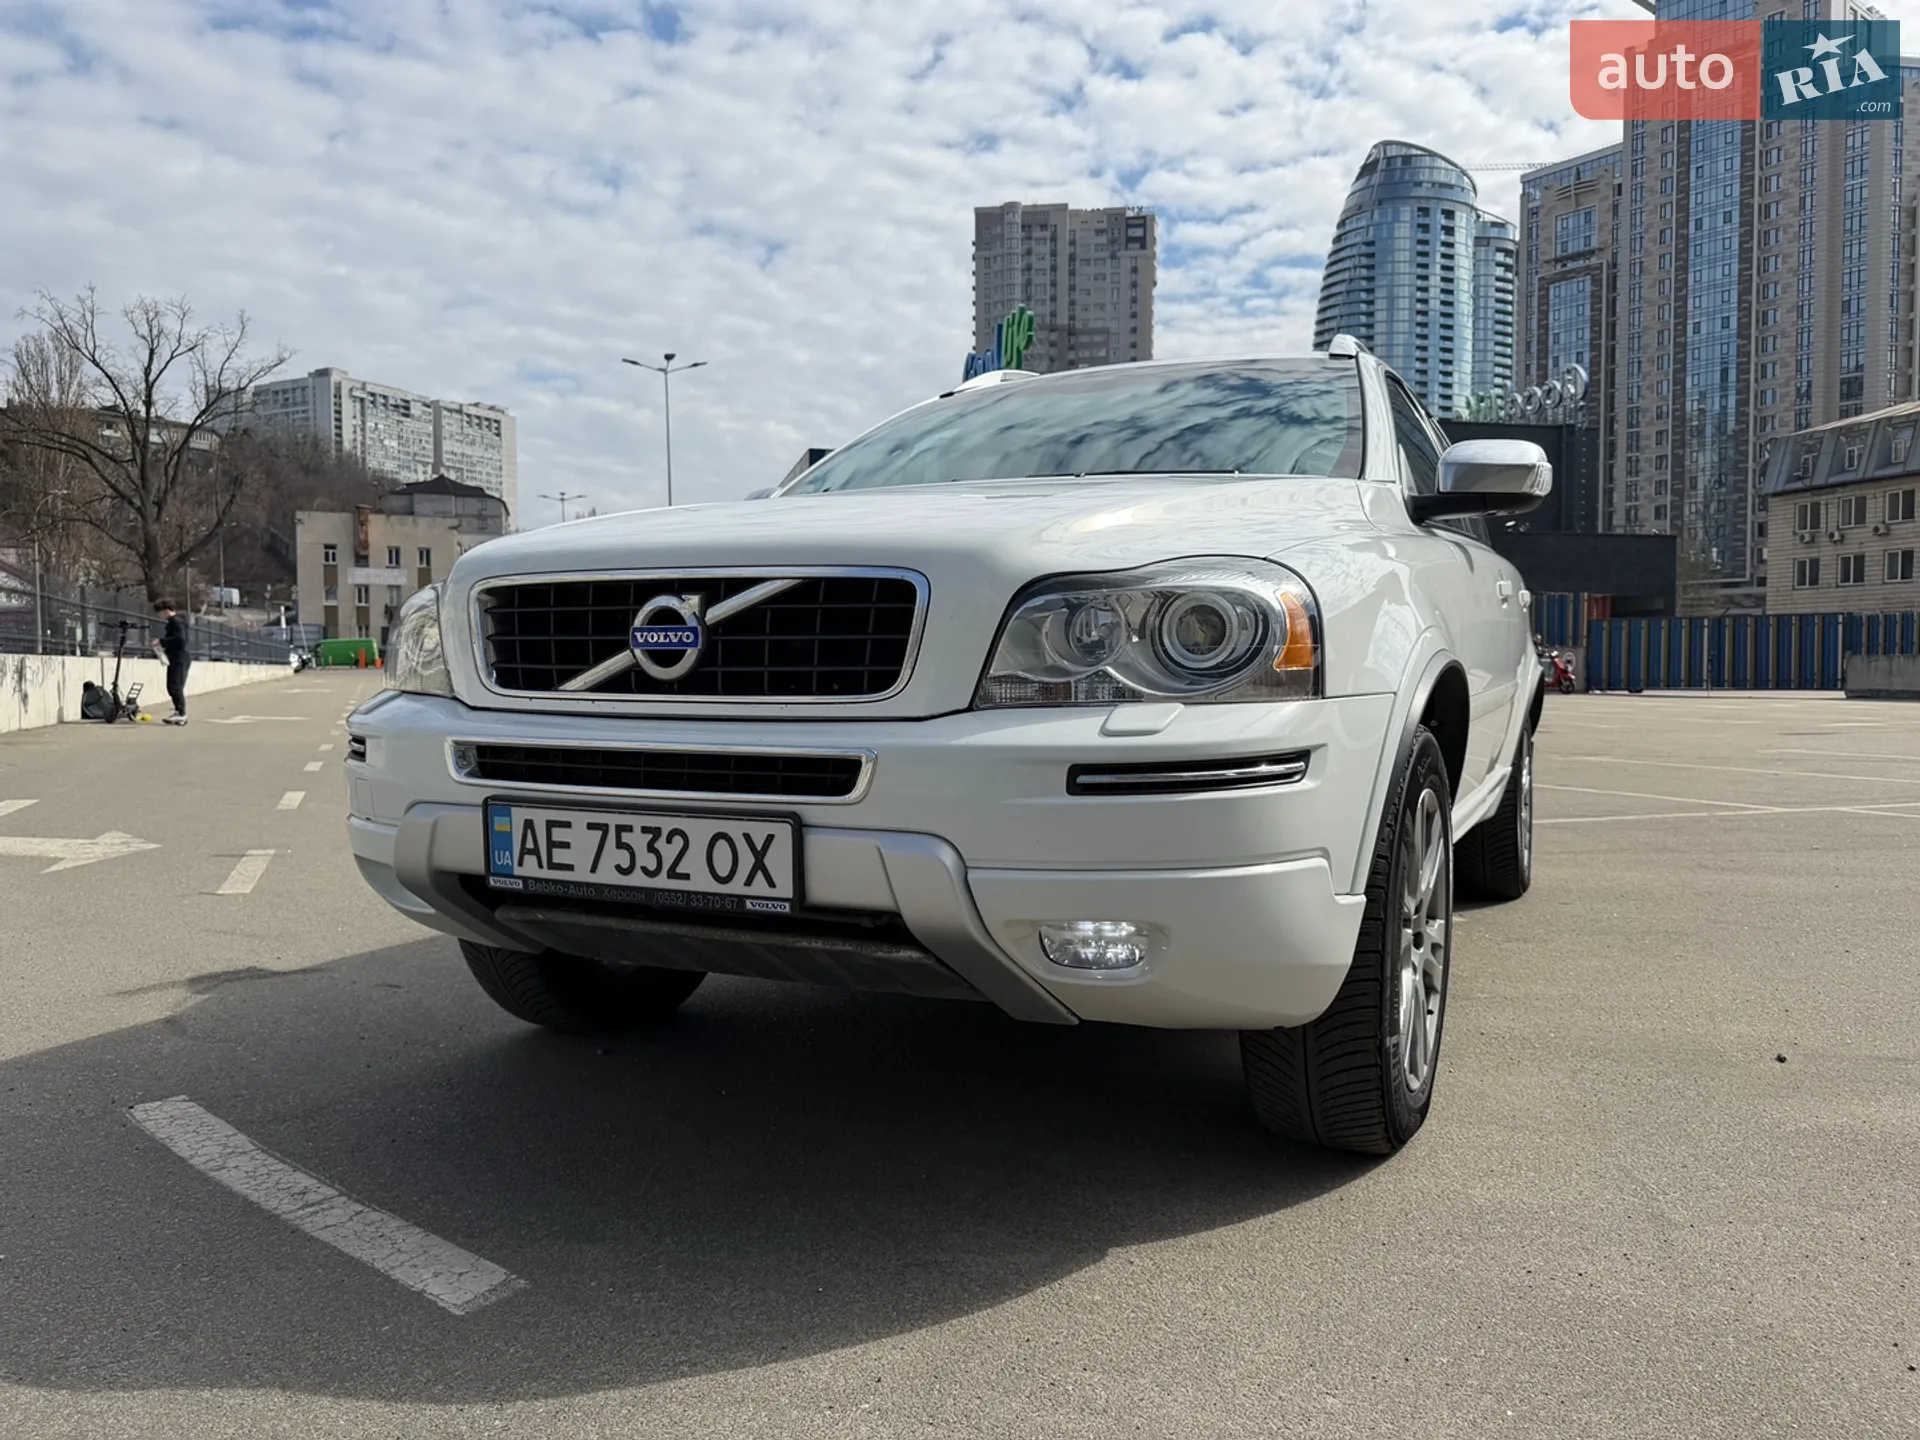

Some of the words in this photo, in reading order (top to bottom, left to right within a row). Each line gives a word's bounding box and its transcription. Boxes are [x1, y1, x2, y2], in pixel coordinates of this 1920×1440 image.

[634, 631, 695, 643] VOLVO
[495, 850, 512, 866] UA
[517, 818, 575, 872] AE
[586, 822, 691, 881] 7532
[706, 831, 777, 889] OX
[492, 878, 520, 887] VOLVO
[602, 887, 645, 900] Херсон
[690, 895, 739, 909] 33-70-67
[750, 901, 787, 911] VOLVO
